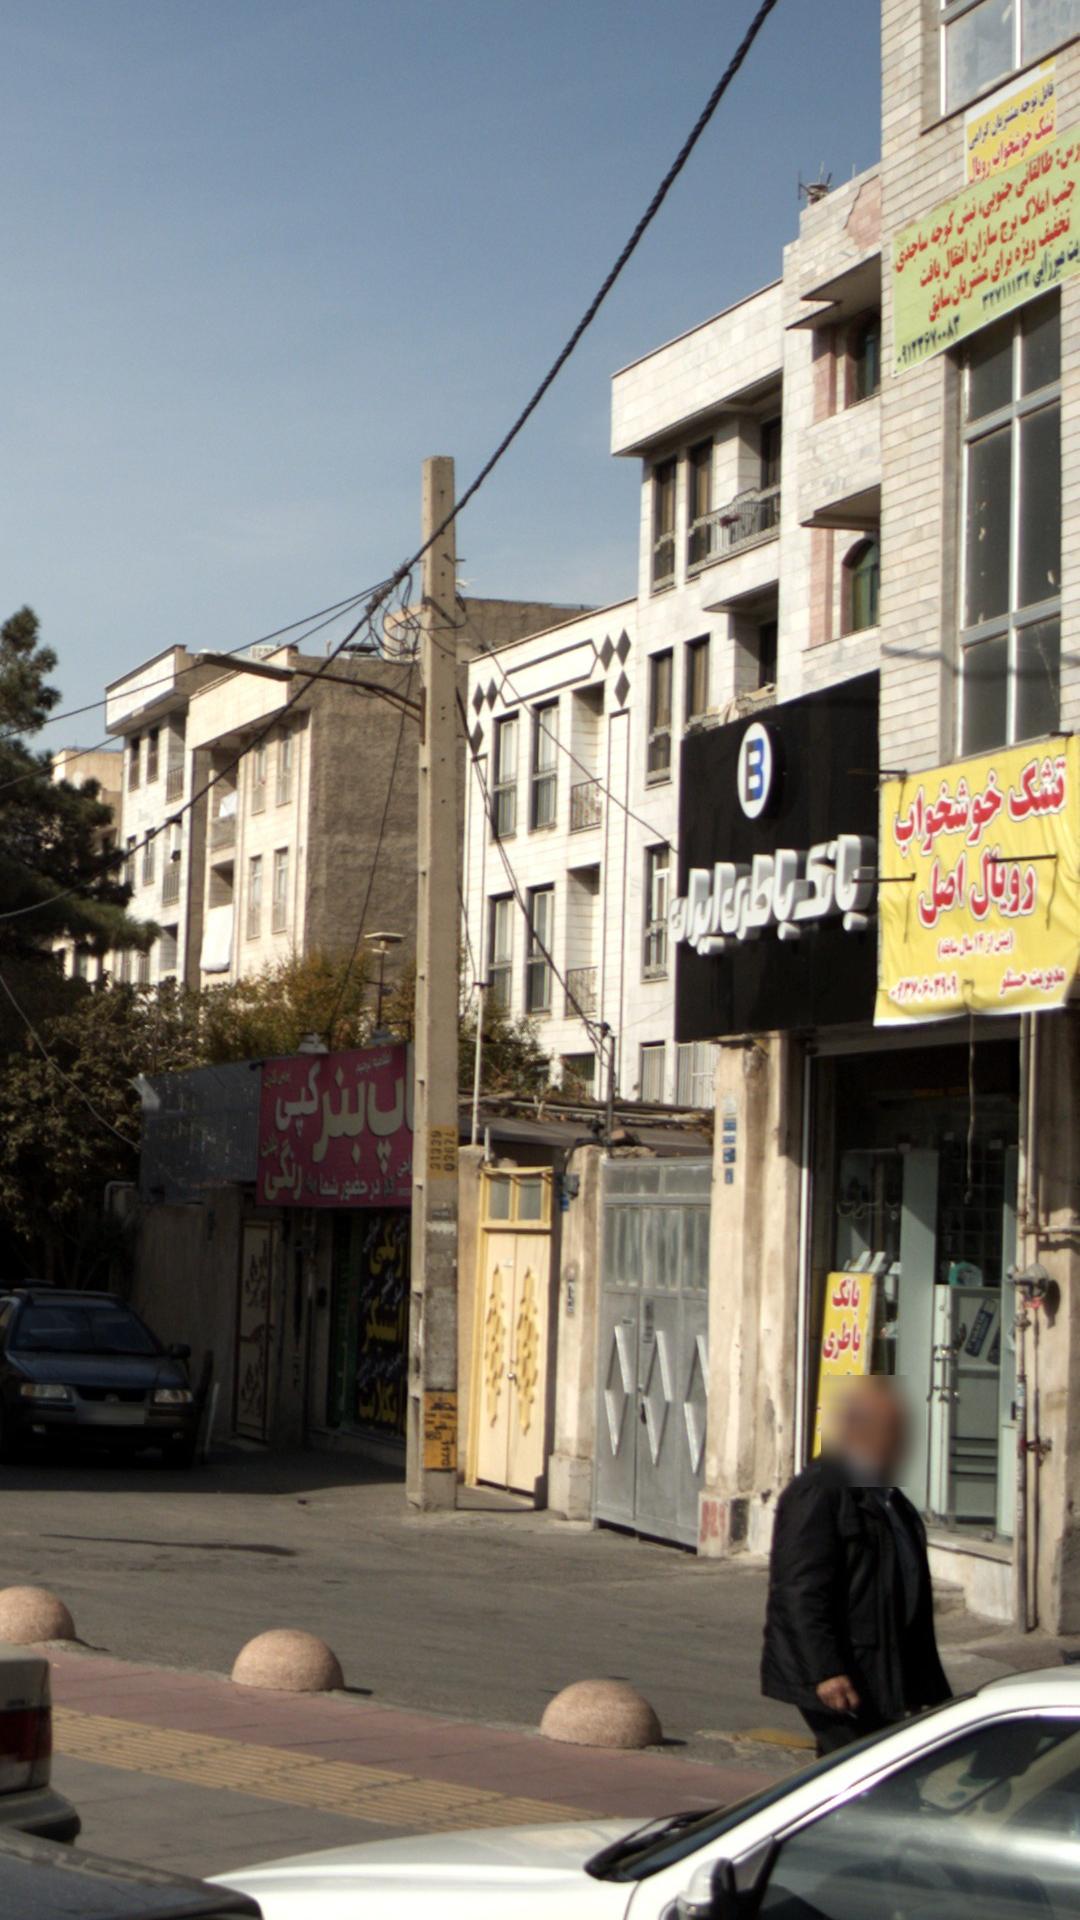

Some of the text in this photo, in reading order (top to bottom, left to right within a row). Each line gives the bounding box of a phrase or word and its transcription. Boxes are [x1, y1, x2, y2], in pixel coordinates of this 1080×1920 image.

[1021, 89, 1038, 116] توجه
[1015, 148, 1053, 198] طالقانی
[1020, 188, 1051, 226] املاک
[1052, 180, 1076, 211] جنب
[931, 210, 955, 246] کوچه
[957, 197, 976, 235] نبش
[1000, 214, 1018, 244] برج
[1038, 207, 1071, 249] تخفیف
[943, 238, 969, 280] انتقال
[991, 248, 1013, 284] برای
[1014, 236, 1036, 268] ویژه
[920, 257, 941, 288] یافت
[951, 266, 989, 307] مشتریان
[929, 287, 951, 322] سابق
[894, 758, 1067, 851] تشک خوشخواب
[667, 834, 872, 956] بانک باطری ایران
[919, 850, 1035, 925] رویال اصل
[960, 935, 973, 956] سال
[1030, 967, 1065, 991] مدیریت
[275, 1060, 321, 1137] کپی
[311, 1065, 365, 1164] بنر
[832, 1279, 860, 1315] بانک
[823, 1321, 861, 1360] باطری
